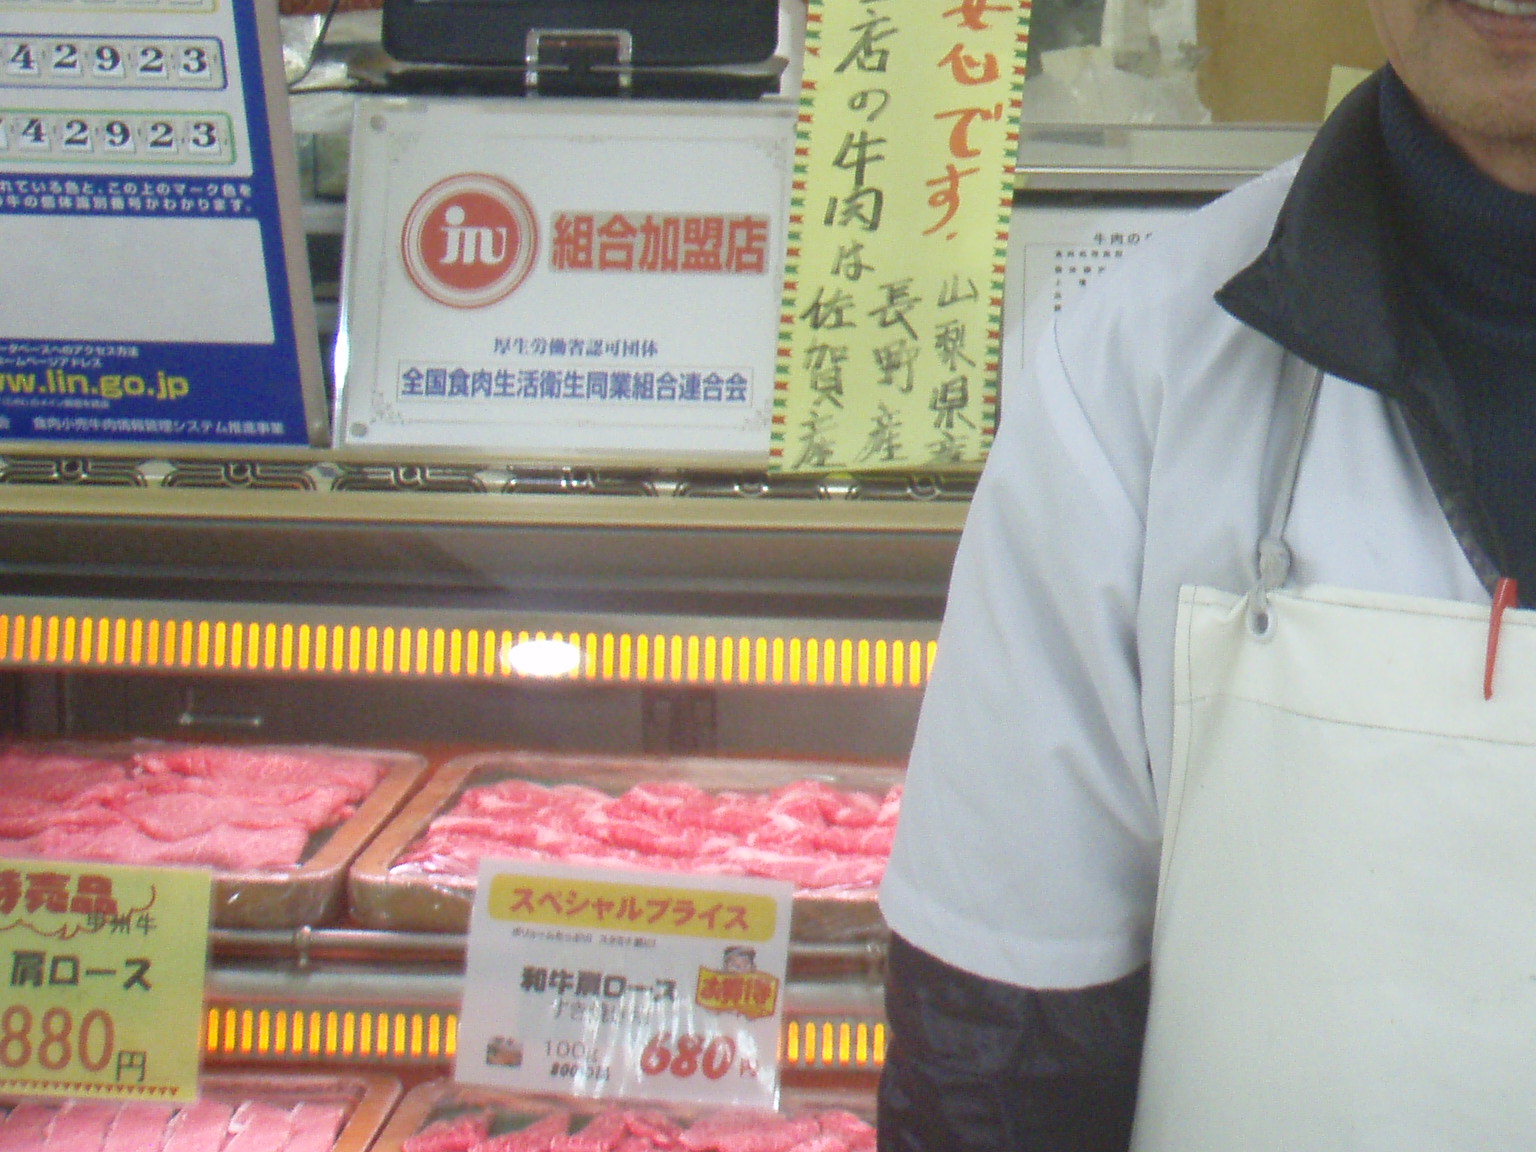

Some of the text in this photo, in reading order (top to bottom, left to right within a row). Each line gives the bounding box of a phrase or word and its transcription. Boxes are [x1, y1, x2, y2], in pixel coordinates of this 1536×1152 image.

[10, 43, 208, 73] 42923
[0, 118, 217, 147] 42923
[553, 214, 769, 272] 組合加盟店
[1093, 232, 1152, 246] 牛肉の
[0, 369, 190, 400] w.lin.go.jp
[401, 367, 749, 402] 全国食肉生活衛生同業組合連合会
[10, 950, 152, 990] 肩ロース
[520, 966, 676, 1001] 和牛肩ロース
[640, 1032, 736, 1080] 680
